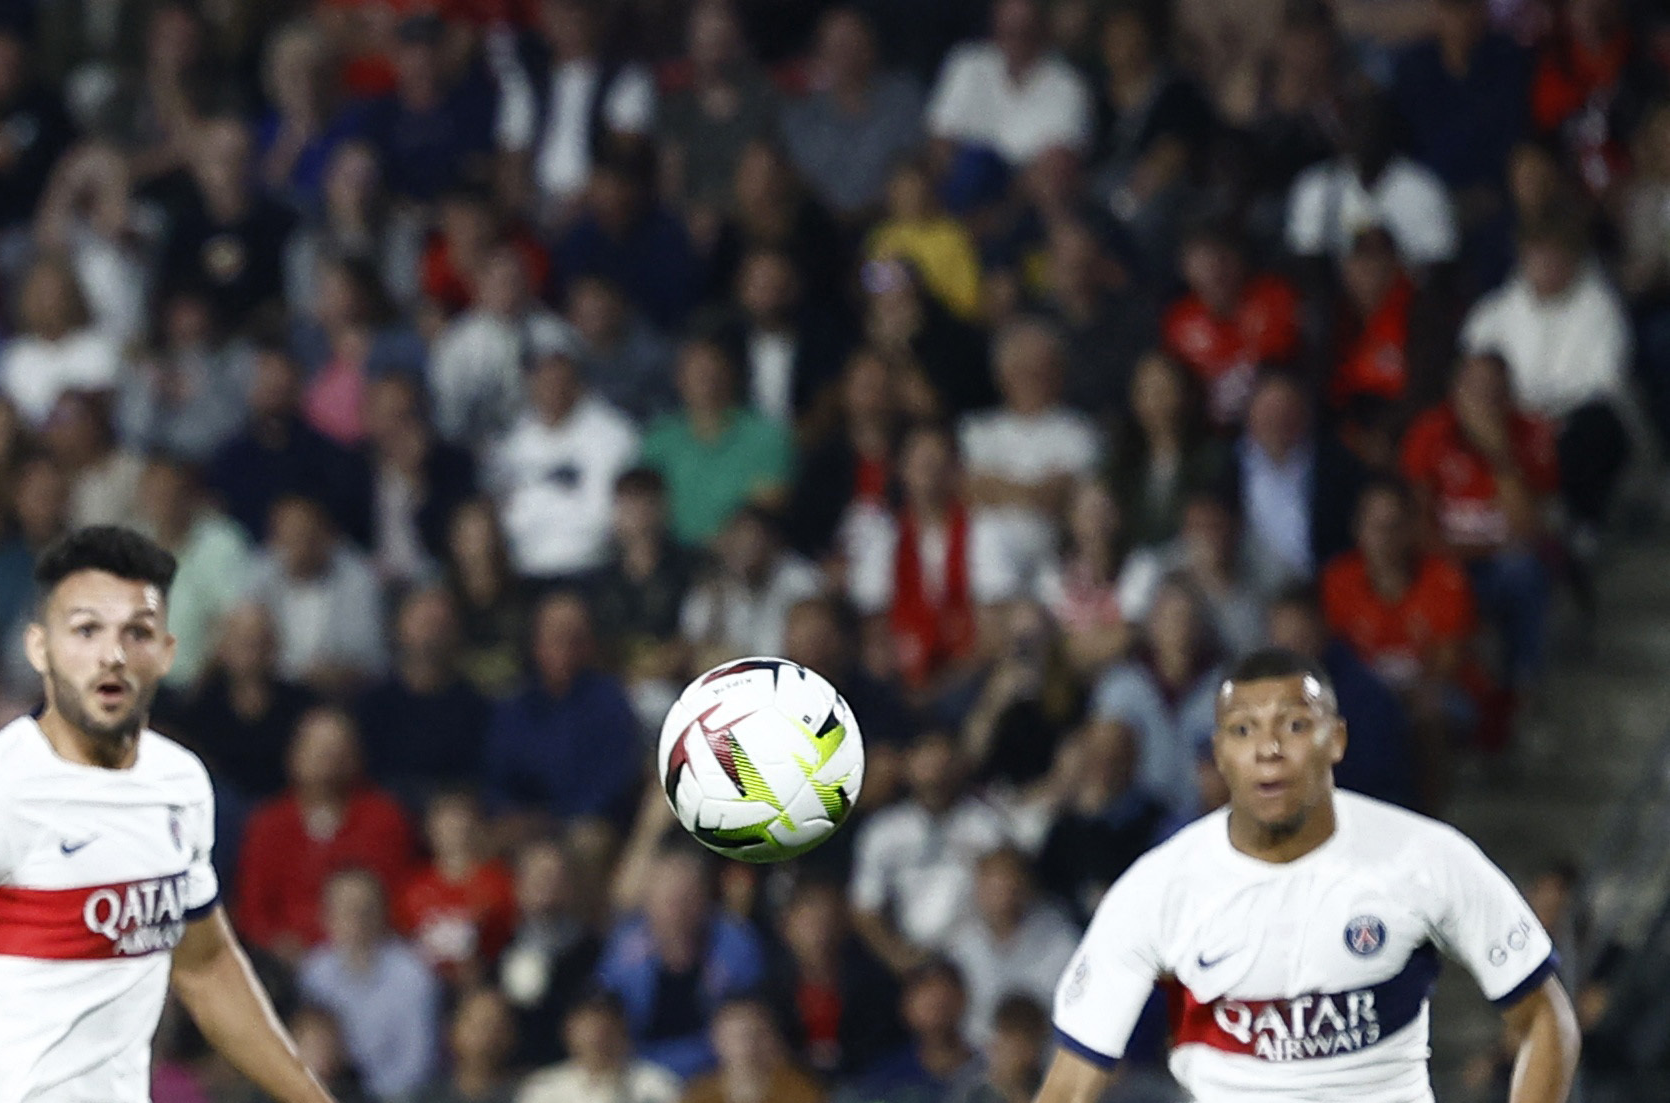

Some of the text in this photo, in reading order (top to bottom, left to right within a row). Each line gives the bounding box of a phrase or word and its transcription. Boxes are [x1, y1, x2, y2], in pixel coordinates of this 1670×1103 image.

[83, 879, 188, 942] QATA
[1214, 990, 1378, 1044] QATAR
[1255, 1022, 1381, 1062] AIRWAYS
